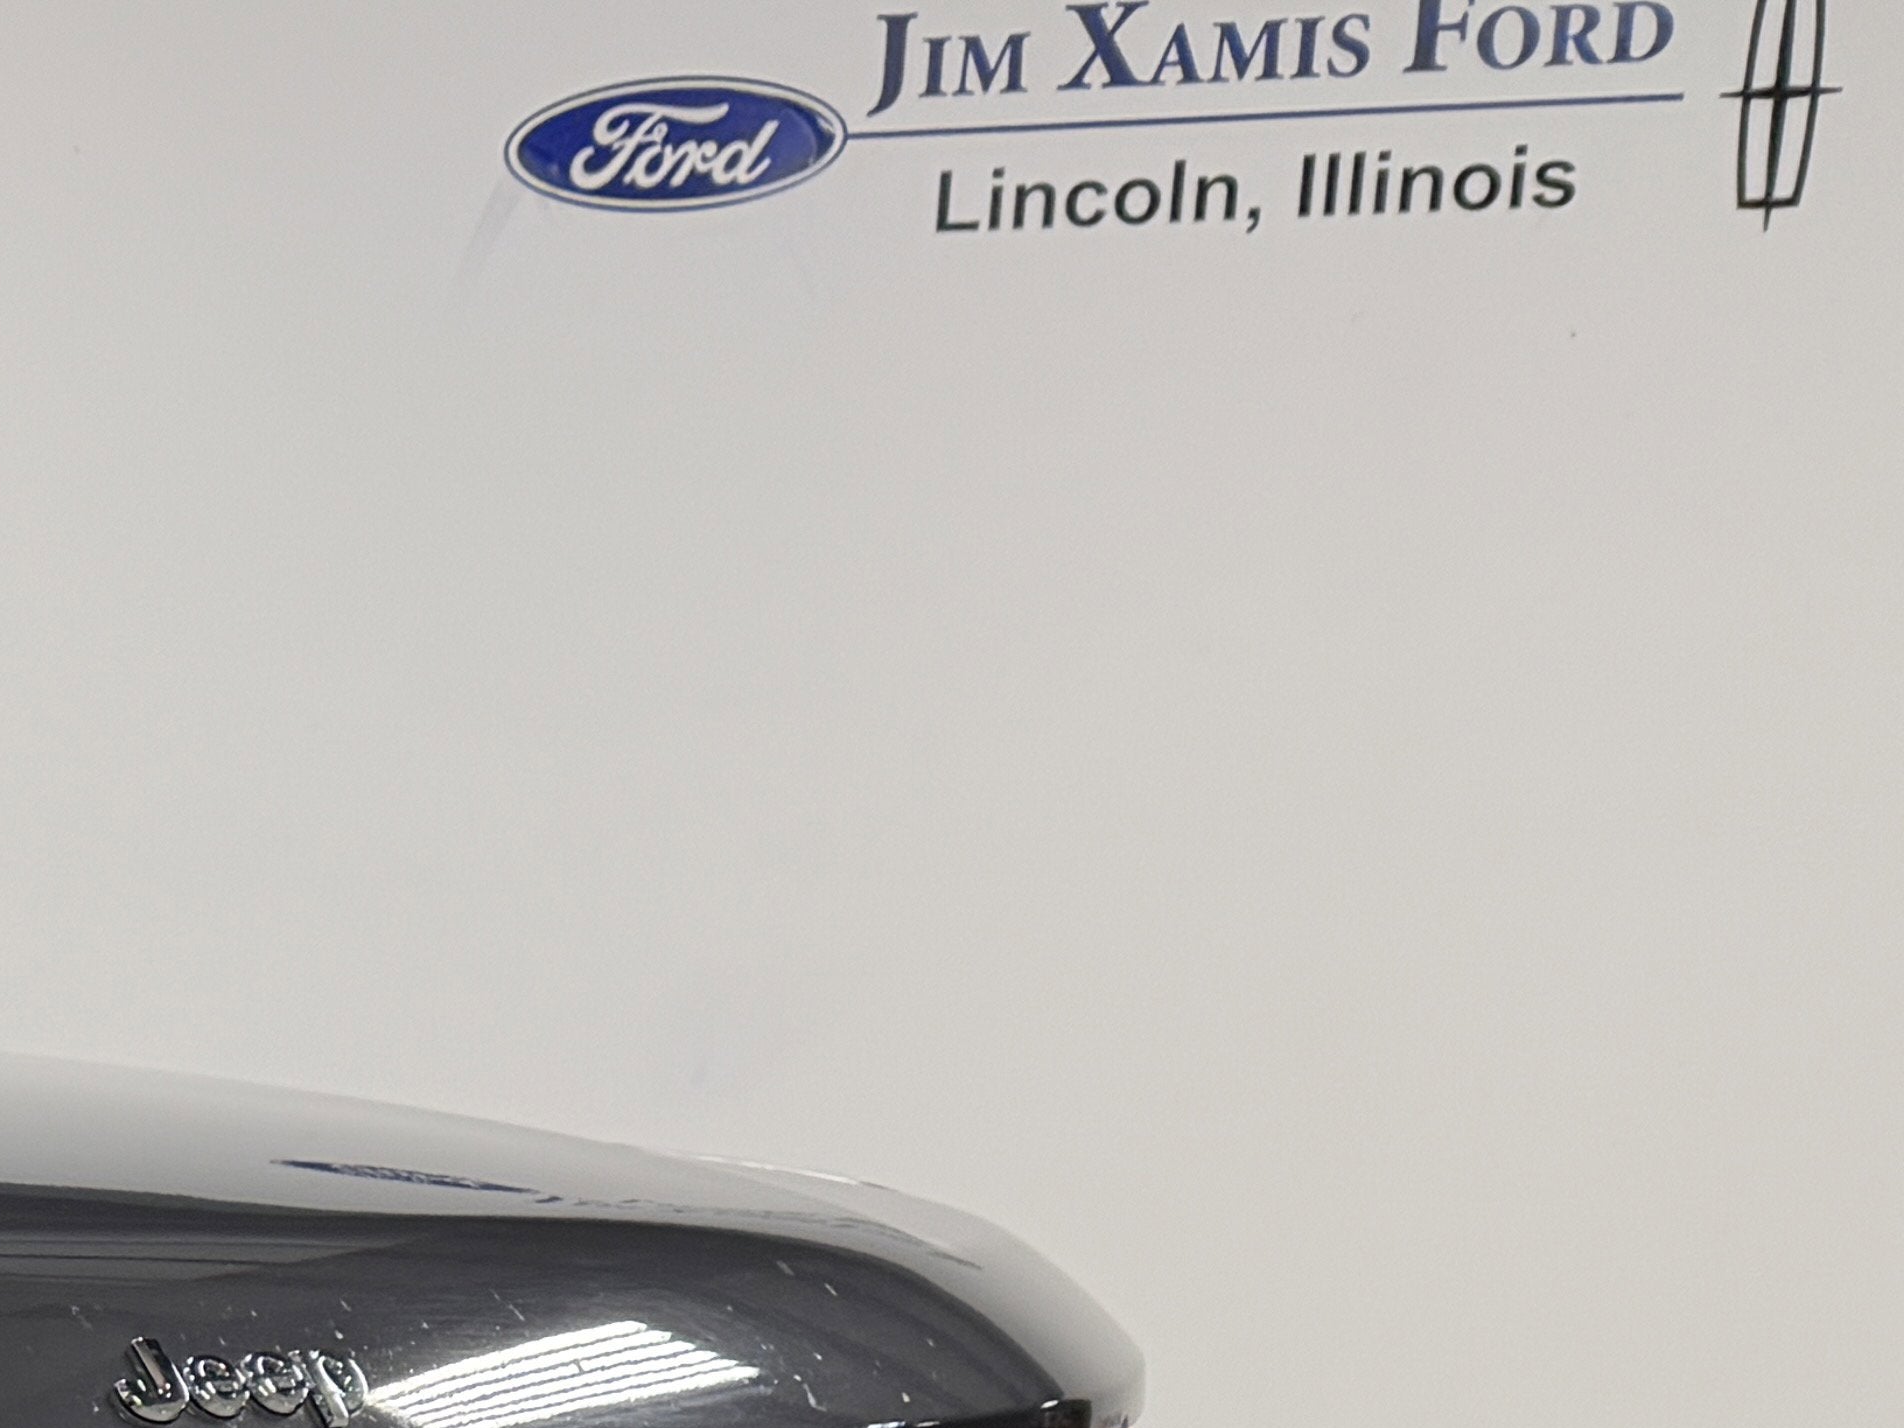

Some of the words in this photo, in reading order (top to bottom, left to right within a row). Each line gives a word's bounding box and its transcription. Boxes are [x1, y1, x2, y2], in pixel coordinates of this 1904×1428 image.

[866, 12, 1031, 118] JIM
[1057, 0, 1371, 91] XAMIS
[1403, 0, 1676, 74] FORD
[569, 101, 780, 190] Ford
[935, 160, 1262, 234] Lincoln,
[1297, 145, 1578, 218] Illinois
